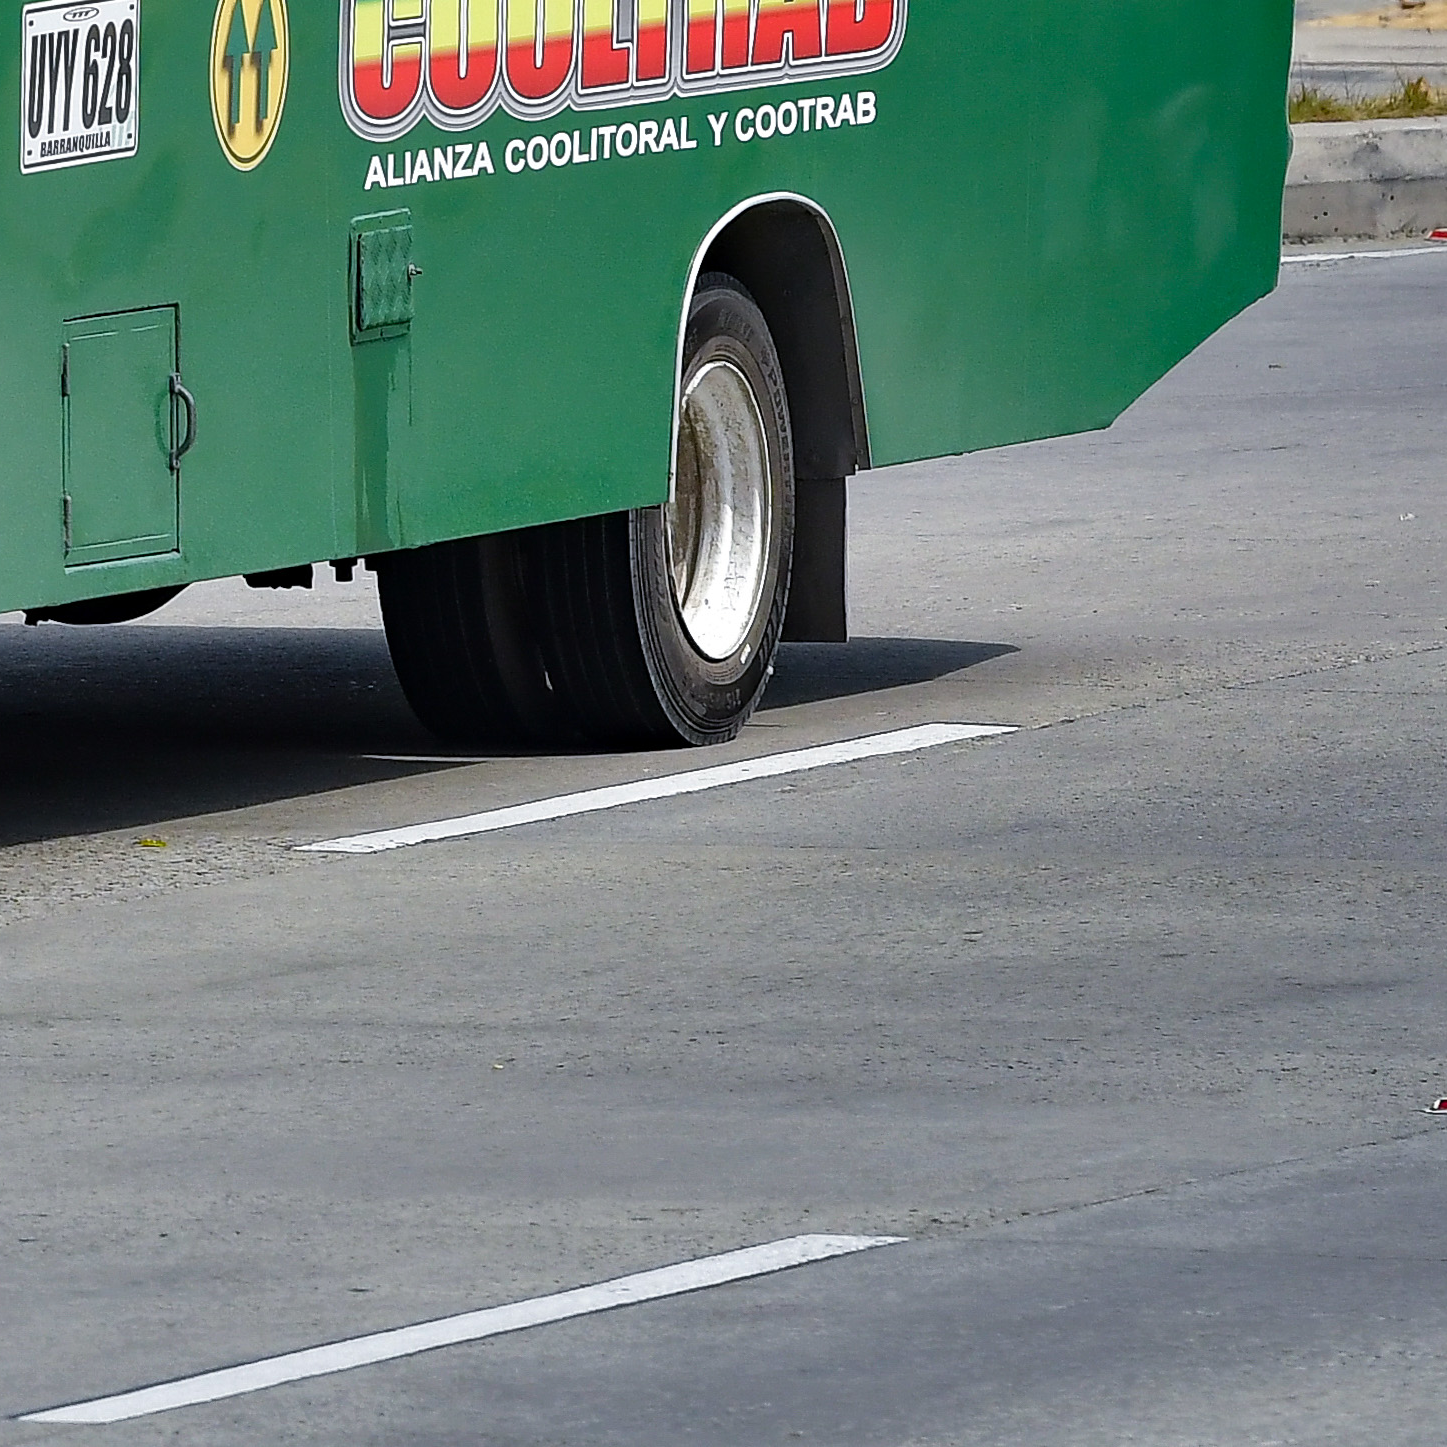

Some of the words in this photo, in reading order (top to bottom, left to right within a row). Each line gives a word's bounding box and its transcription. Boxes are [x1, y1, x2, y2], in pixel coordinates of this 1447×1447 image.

[28, 28, 80, 139] UYY
[82, 18, 134, 129] 628
[40, 130, 111, 158] BARRANQUILLA
[364, 142, 494, 190] ALIANZA
[505, 117, 697, 173] COOLITORAL
[709, 113, 730, 147] Y
[735, 92, 877, 142] COOTRAB
